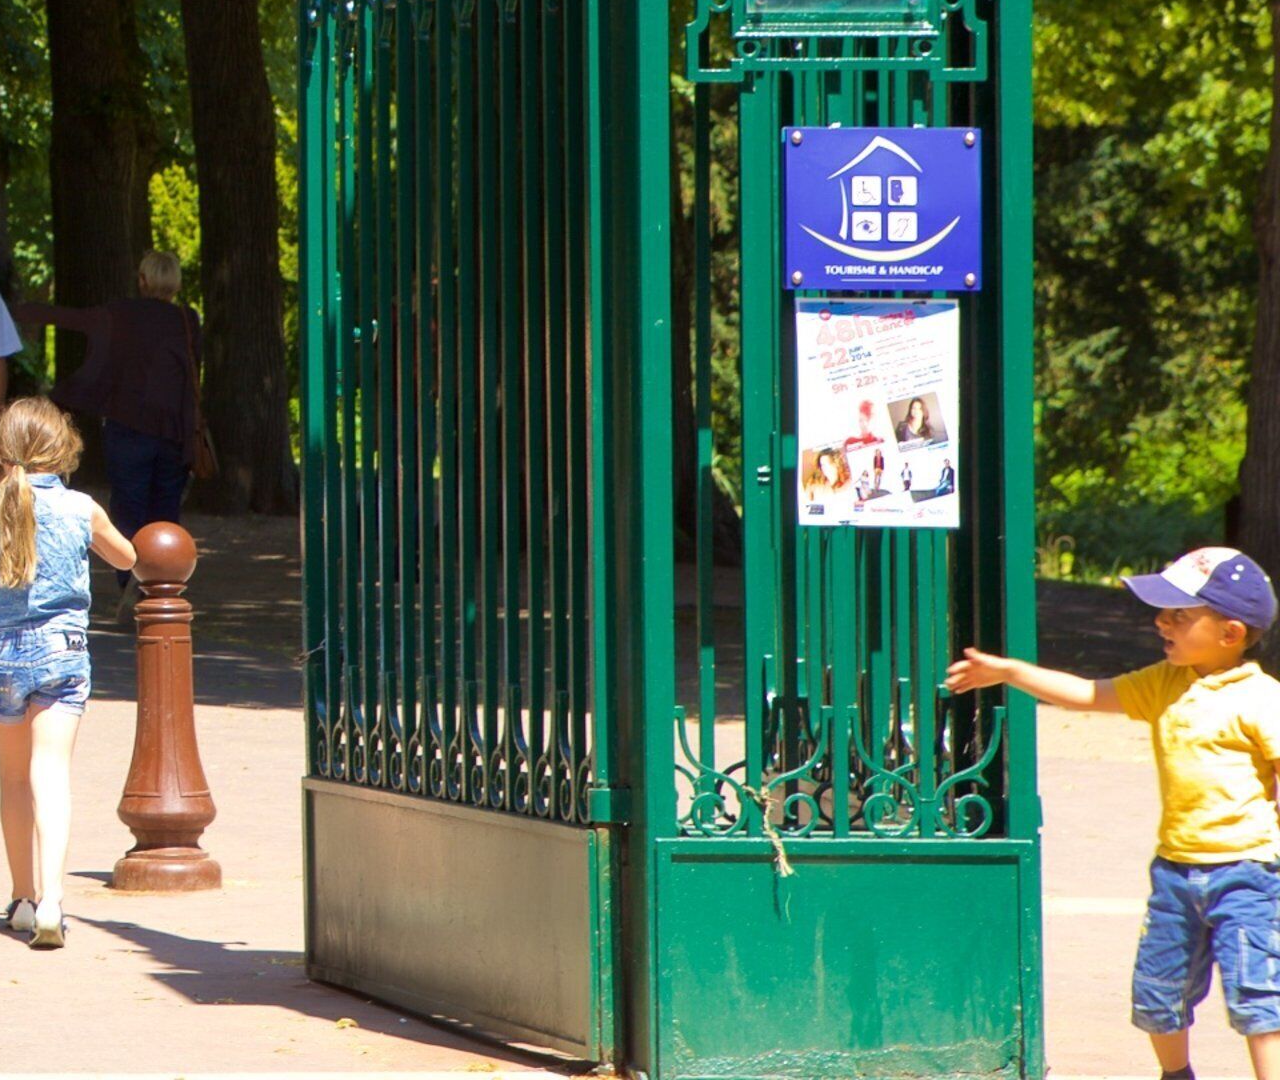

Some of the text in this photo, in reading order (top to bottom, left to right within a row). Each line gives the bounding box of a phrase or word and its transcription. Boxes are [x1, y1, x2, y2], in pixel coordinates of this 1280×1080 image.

[824, 265, 944, 275] TOURISME & HANDICAP
